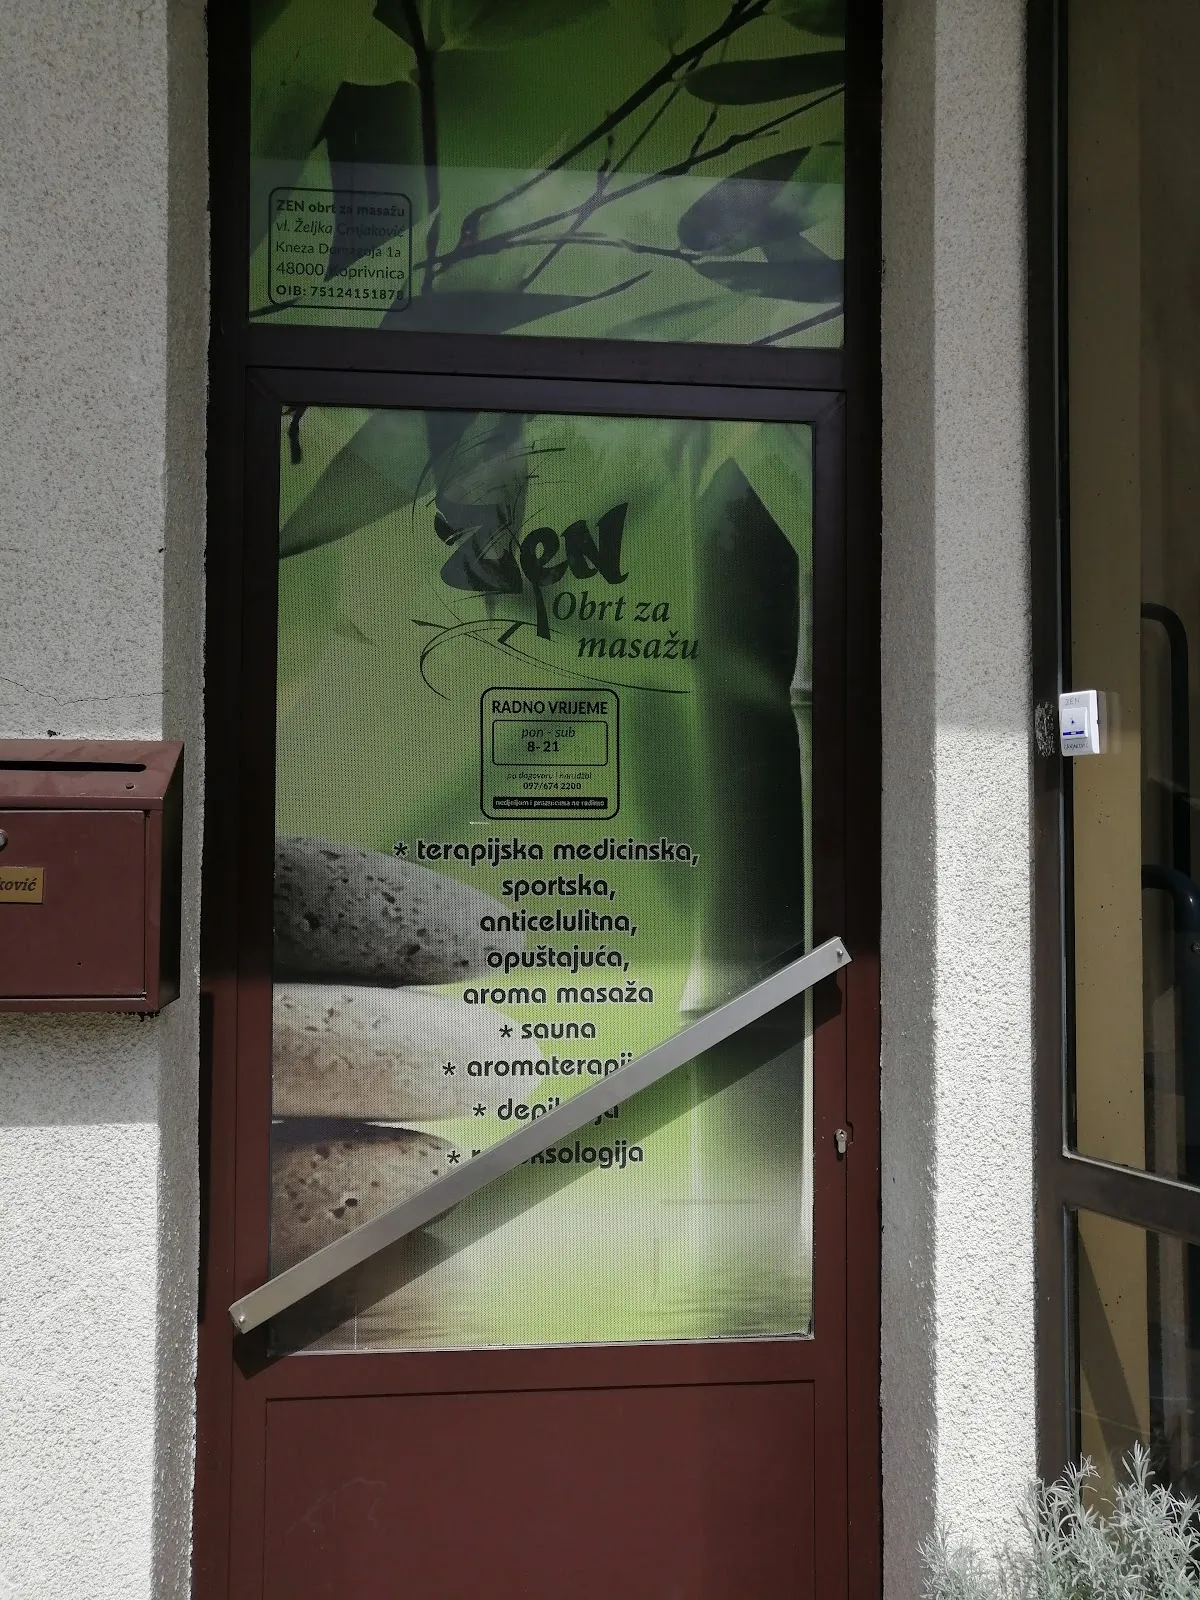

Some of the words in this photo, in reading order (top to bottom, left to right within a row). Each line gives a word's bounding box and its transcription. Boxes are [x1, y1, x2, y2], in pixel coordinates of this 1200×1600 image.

[275, 200, 305, 212] ZEN
[308, 202, 336, 213] obrt
[339, 204, 353, 215] za
[357, 204, 405, 217] masažu
[294, 218, 332, 236] Željka
[276, 241, 314, 254] Kneza
[387, 246, 401, 258] 1a
[276, 261, 324, 276] 48000
[329, 263, 405, 281] Koprivnica
[275, 284, 307, 296] OIB:
[552, 591, 626, 623] Obrt
[634, 600, 671, 623] za
[577, 630, 700, 660] masažu
[491, 700, 546, 714] RADNO
[548, 701, 608, 715] VRIJEME
[521, 728, 544, 739] pon
[554, 726, 576, 738] sub
[560, 782, 582, 790] 2200
[416, 838, 544, 867] terapijska
[553, 838, 699, 866] medicinska,
[502, 874, 617, 901] sportska,
[479, 909, 638, 937] anticelulitna,
[486, 945, 630, 974] opuštajuća,
[463, 986, 547, 1005] aroma
[556, 980, 654, 1005] masaža
[520, 1022, 597, 1040] sauna
